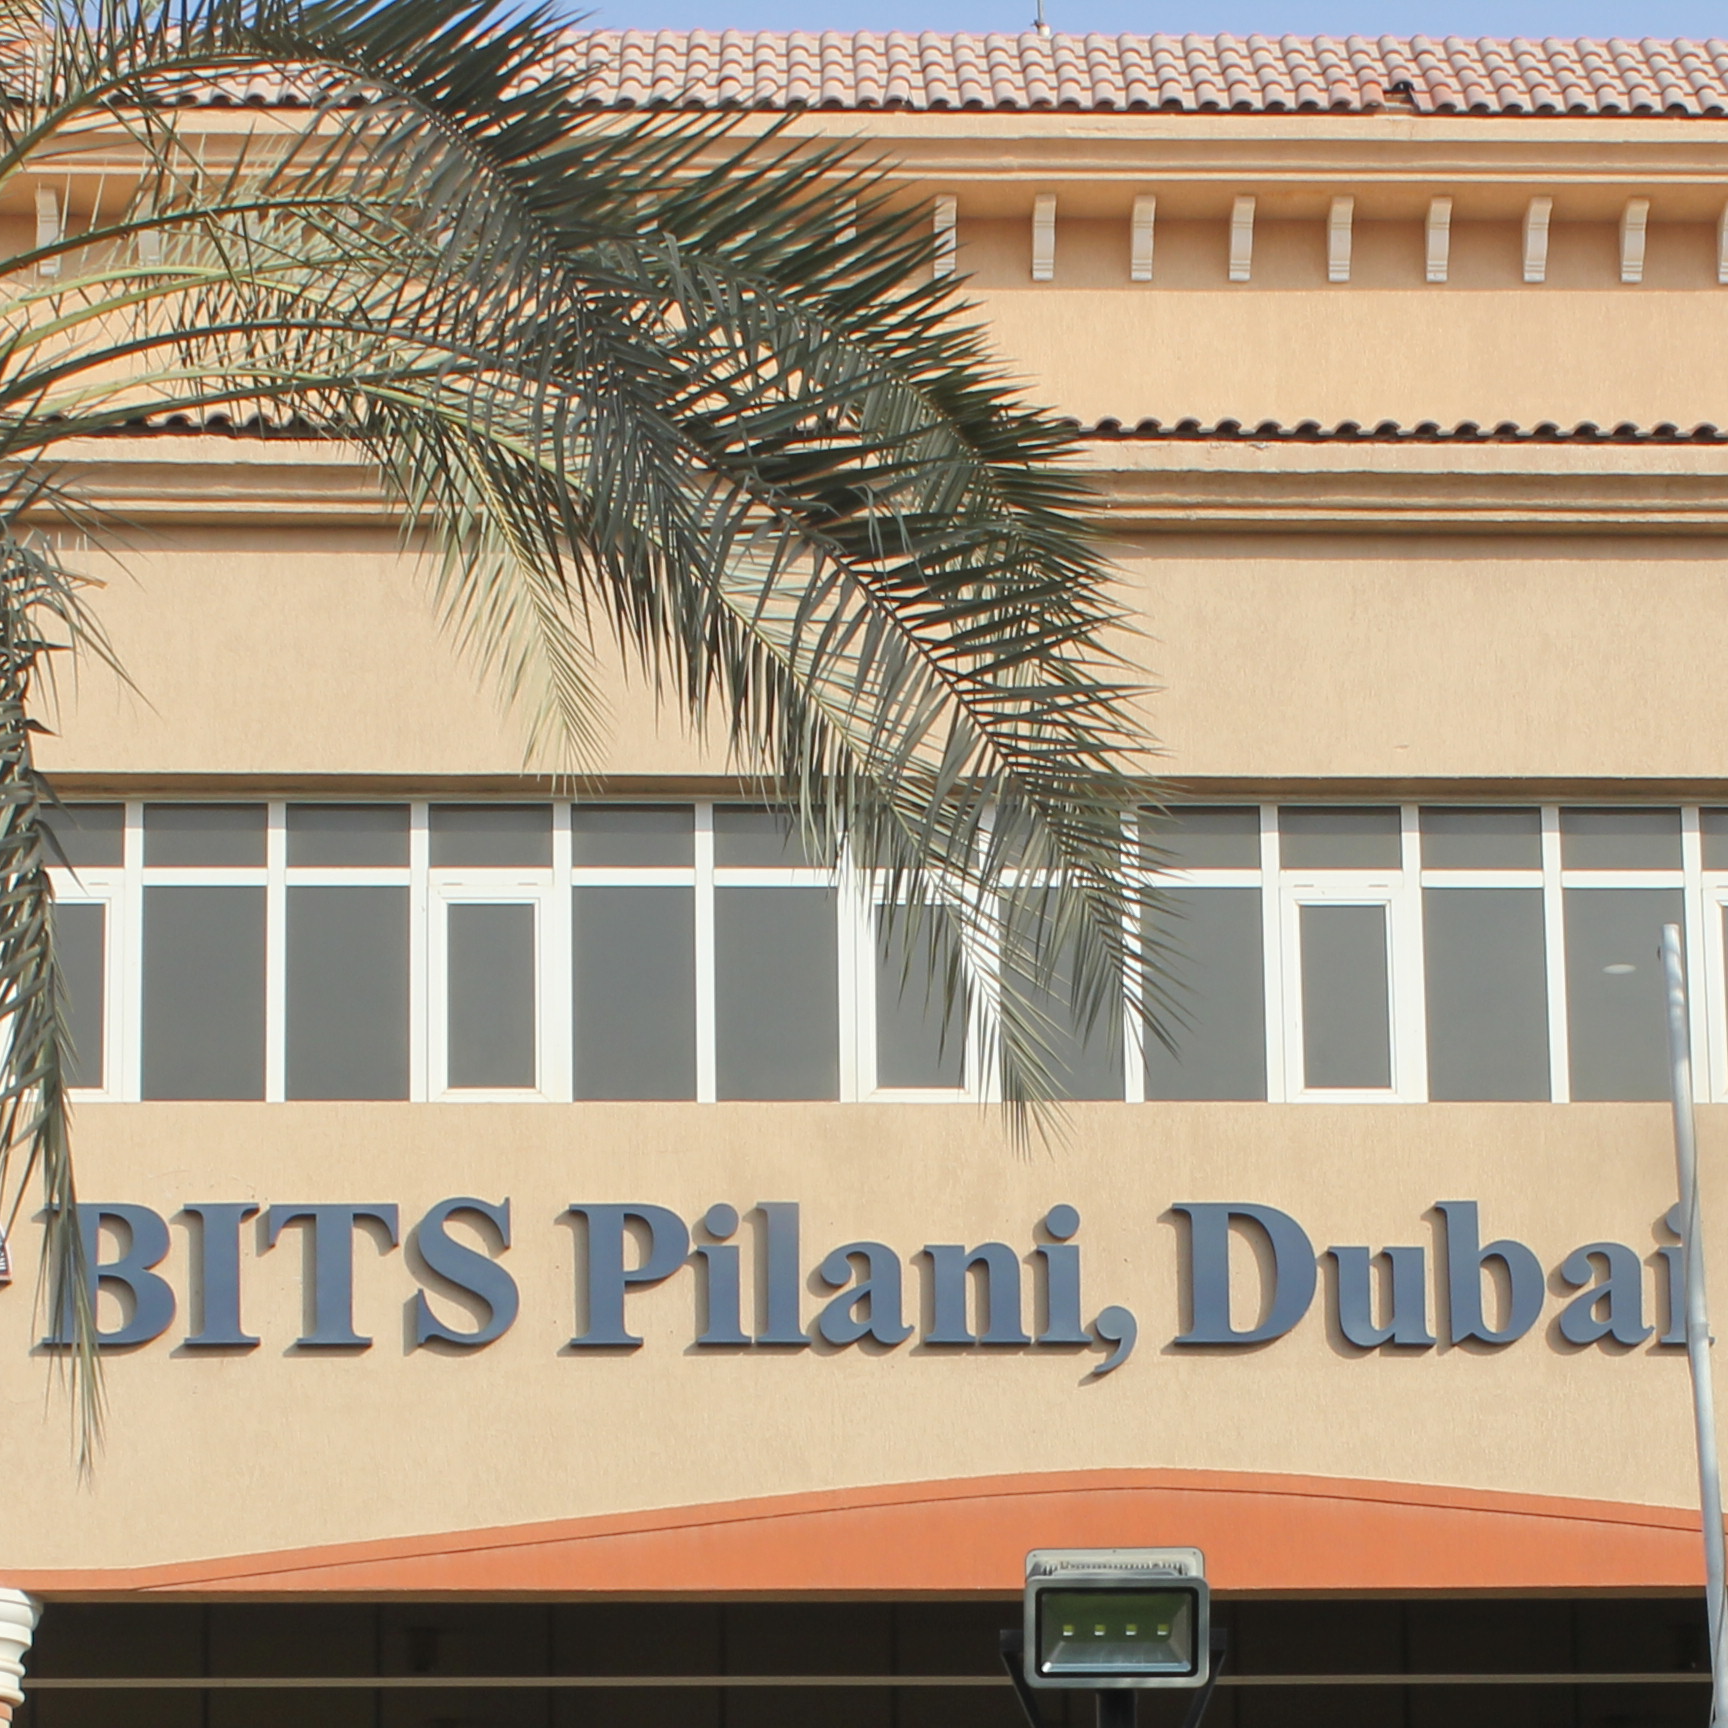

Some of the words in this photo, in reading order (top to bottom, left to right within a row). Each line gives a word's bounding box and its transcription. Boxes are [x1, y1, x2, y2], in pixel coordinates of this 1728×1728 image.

[41, 1196, 520, 1349] BITS
[569, 1201, 1138, 1374] Pilani,
[1172, 1200, 1715, 1347] Dubai
